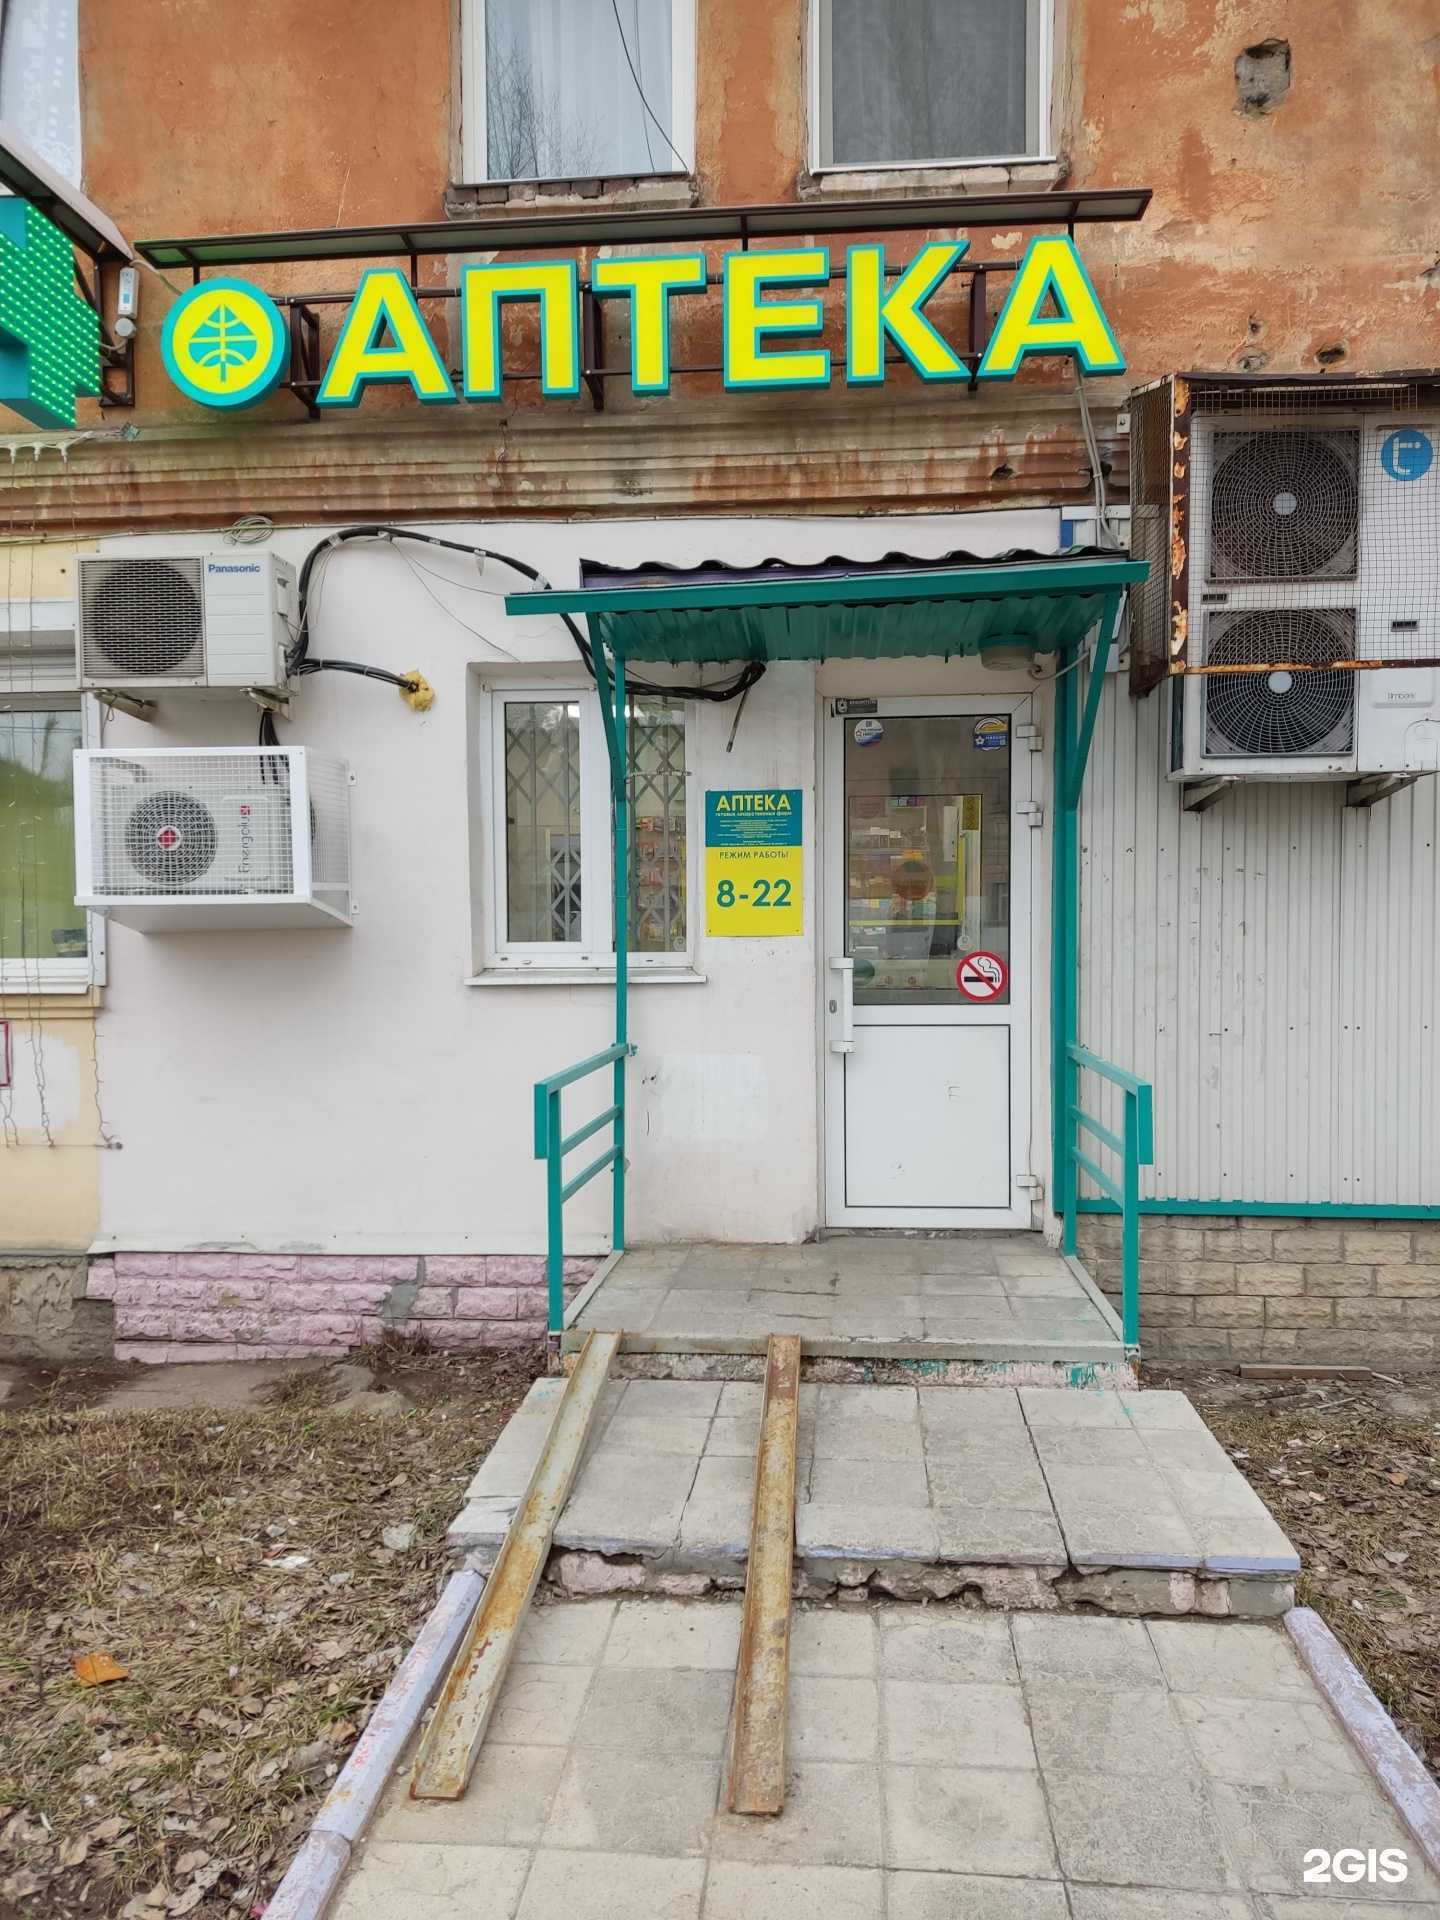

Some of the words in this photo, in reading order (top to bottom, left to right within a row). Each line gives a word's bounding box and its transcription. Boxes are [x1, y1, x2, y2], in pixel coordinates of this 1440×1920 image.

[316, 235, 1126, 406] АПТЕКА
[207, 562, 261, 574] Panasonic
[716, 794, 791, 812] АПТЕКА
[719, 851, 751, 859] РЕЖИМ
[753, 850, 789, 859] РАБОТЫ
